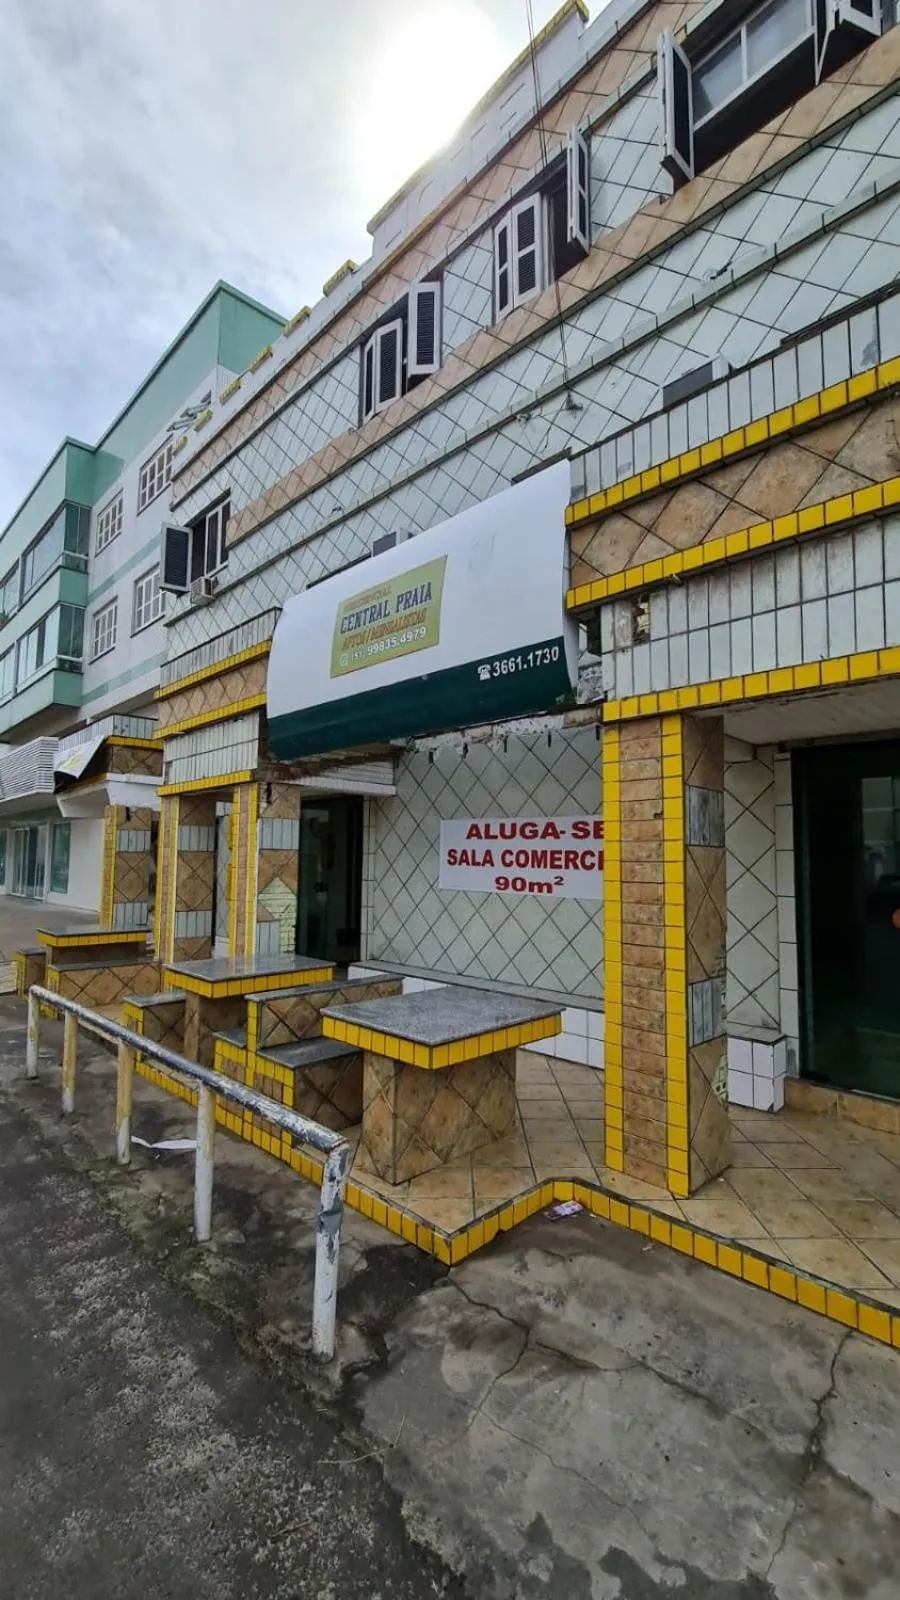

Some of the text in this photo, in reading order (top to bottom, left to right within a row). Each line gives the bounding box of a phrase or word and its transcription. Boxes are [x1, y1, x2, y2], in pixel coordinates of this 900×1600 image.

[340, 599, 391, 634] CENTRAL
[395, 582, 432, 613] PRAIA
[492, 646, 559, 677] 3661.1730
[447, 848, 495, 867] SALA
